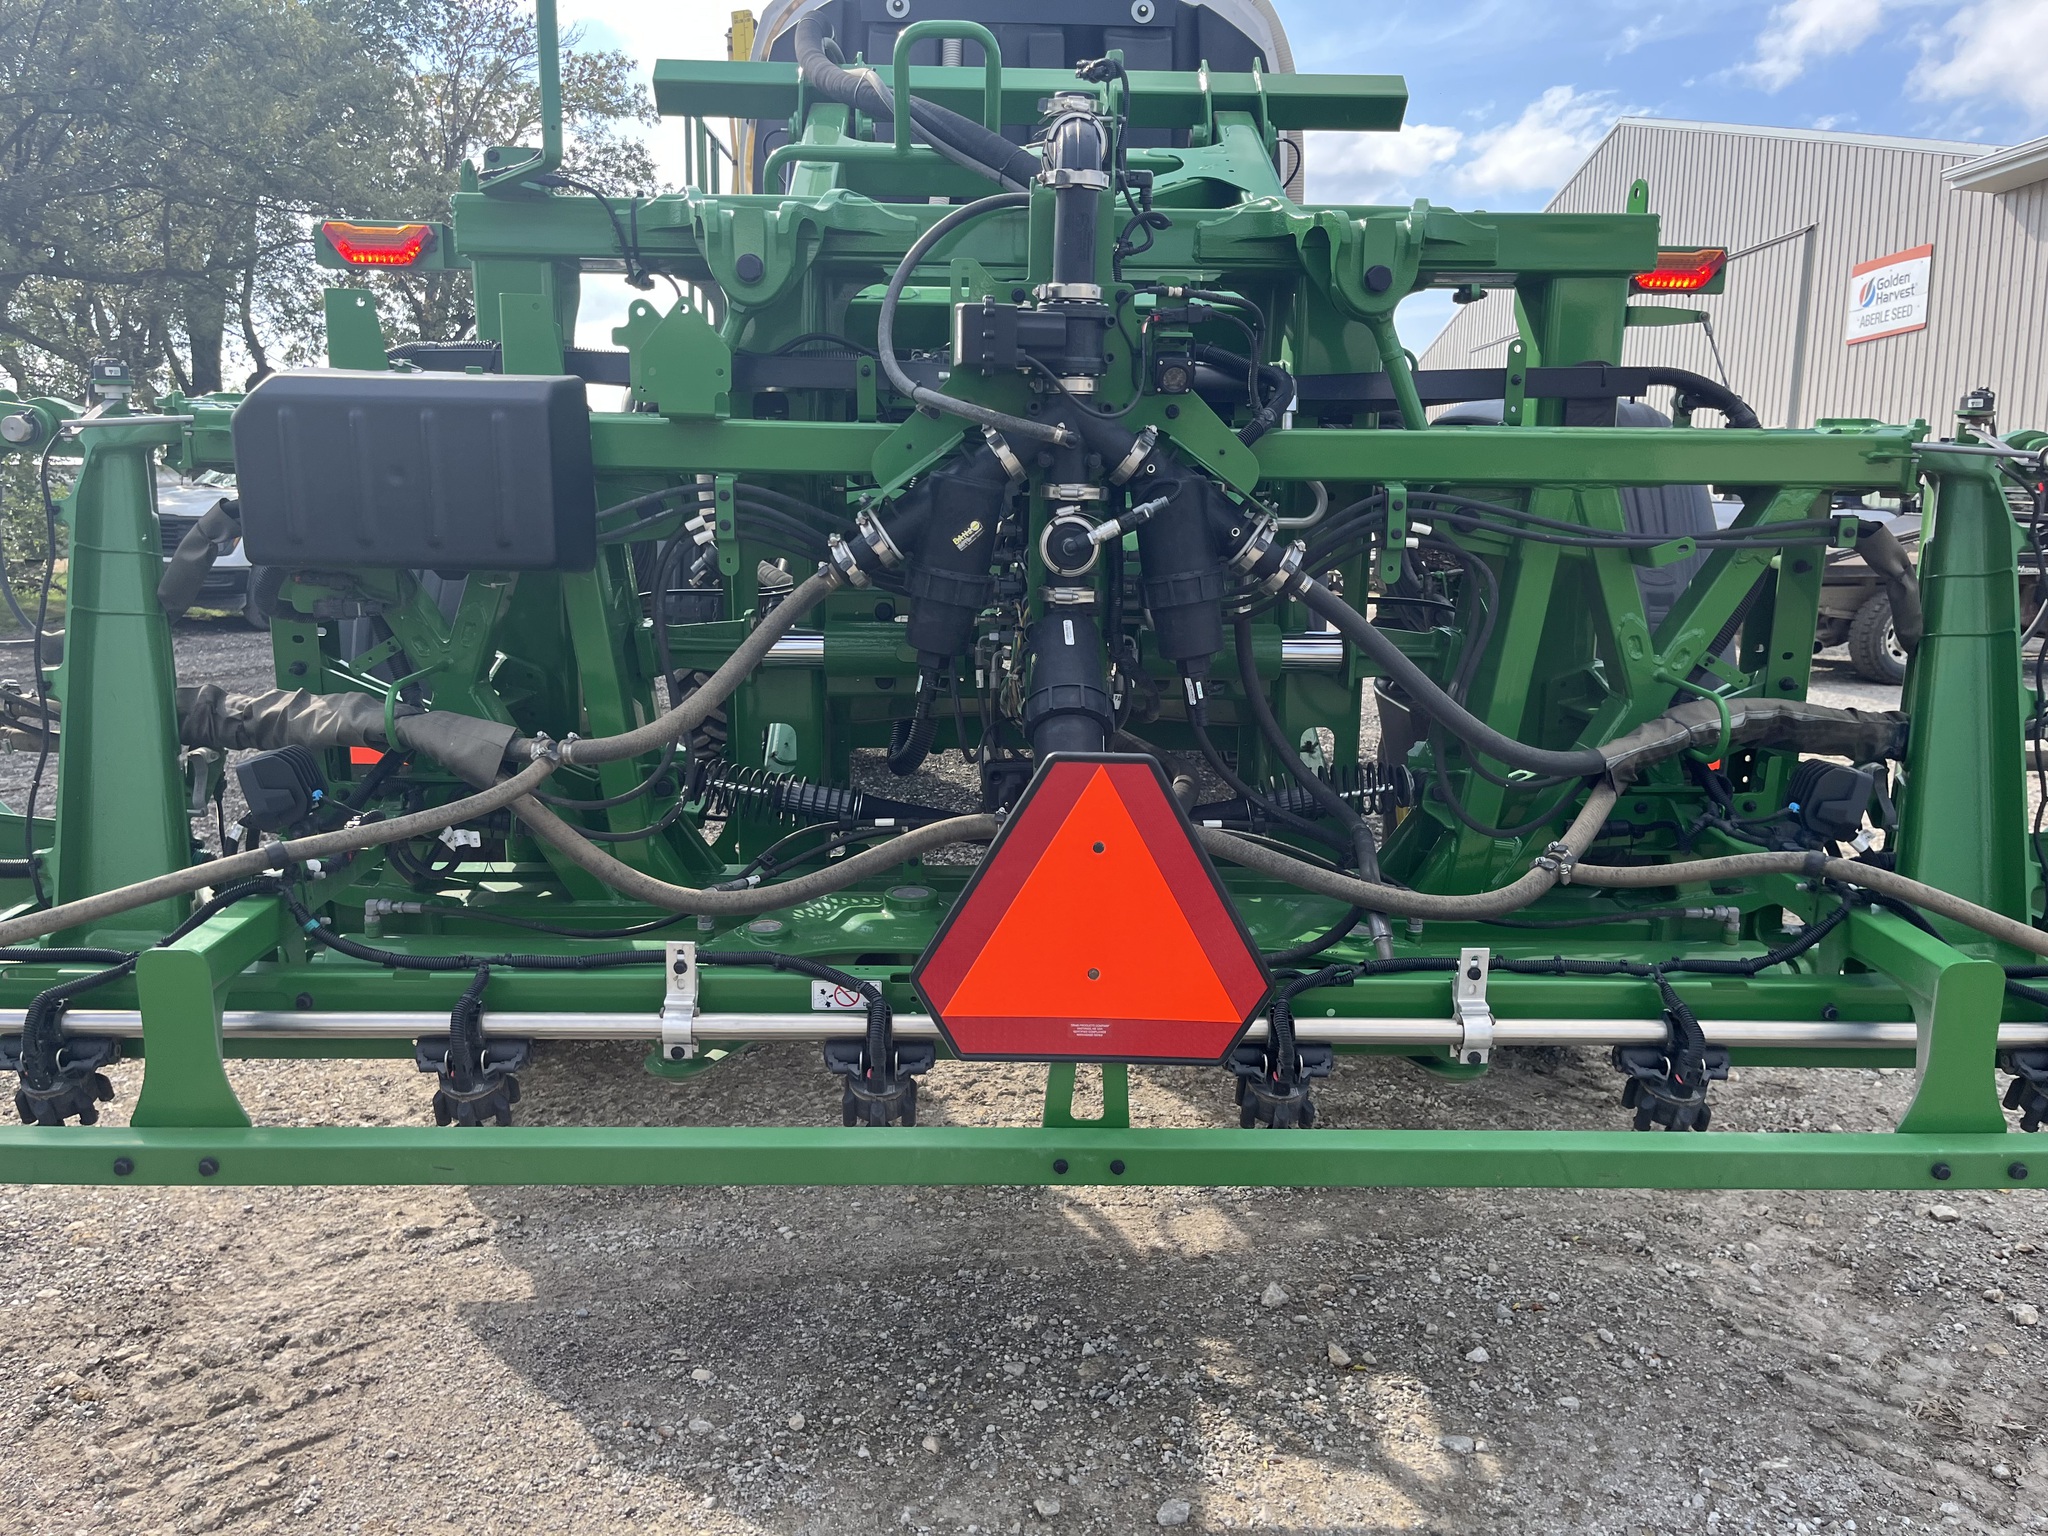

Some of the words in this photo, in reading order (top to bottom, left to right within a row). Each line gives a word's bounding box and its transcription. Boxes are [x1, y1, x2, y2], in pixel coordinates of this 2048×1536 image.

[1877, 273, 1910, 290] Golden
[1876, 284, 1915, 305] Harvest
[1860, 309, 1890, 328] ABERLE
[1891, 304, 1912, 320] SEED
